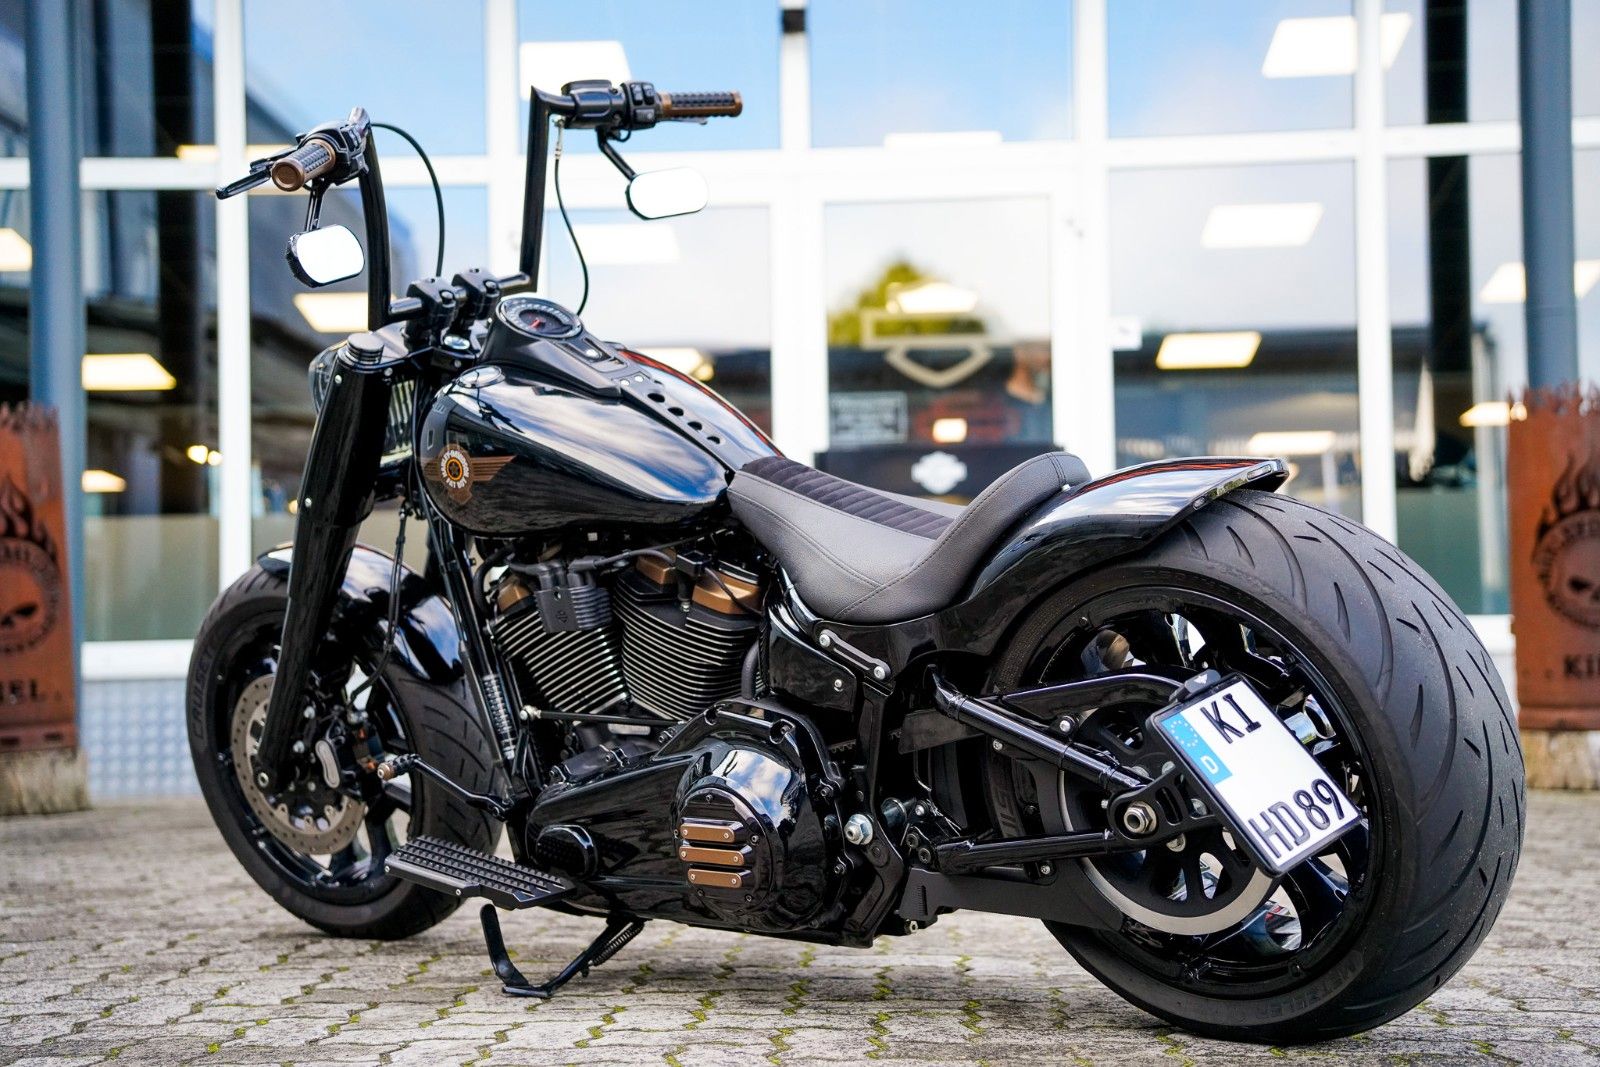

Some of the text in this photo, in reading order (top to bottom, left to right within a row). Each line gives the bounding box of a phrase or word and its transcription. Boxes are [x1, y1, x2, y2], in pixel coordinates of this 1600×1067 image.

[1563, 653, 1600, 679] KI
[1199, 693, 1262, 744] KI
[1199, 754, 1220, 775] D
